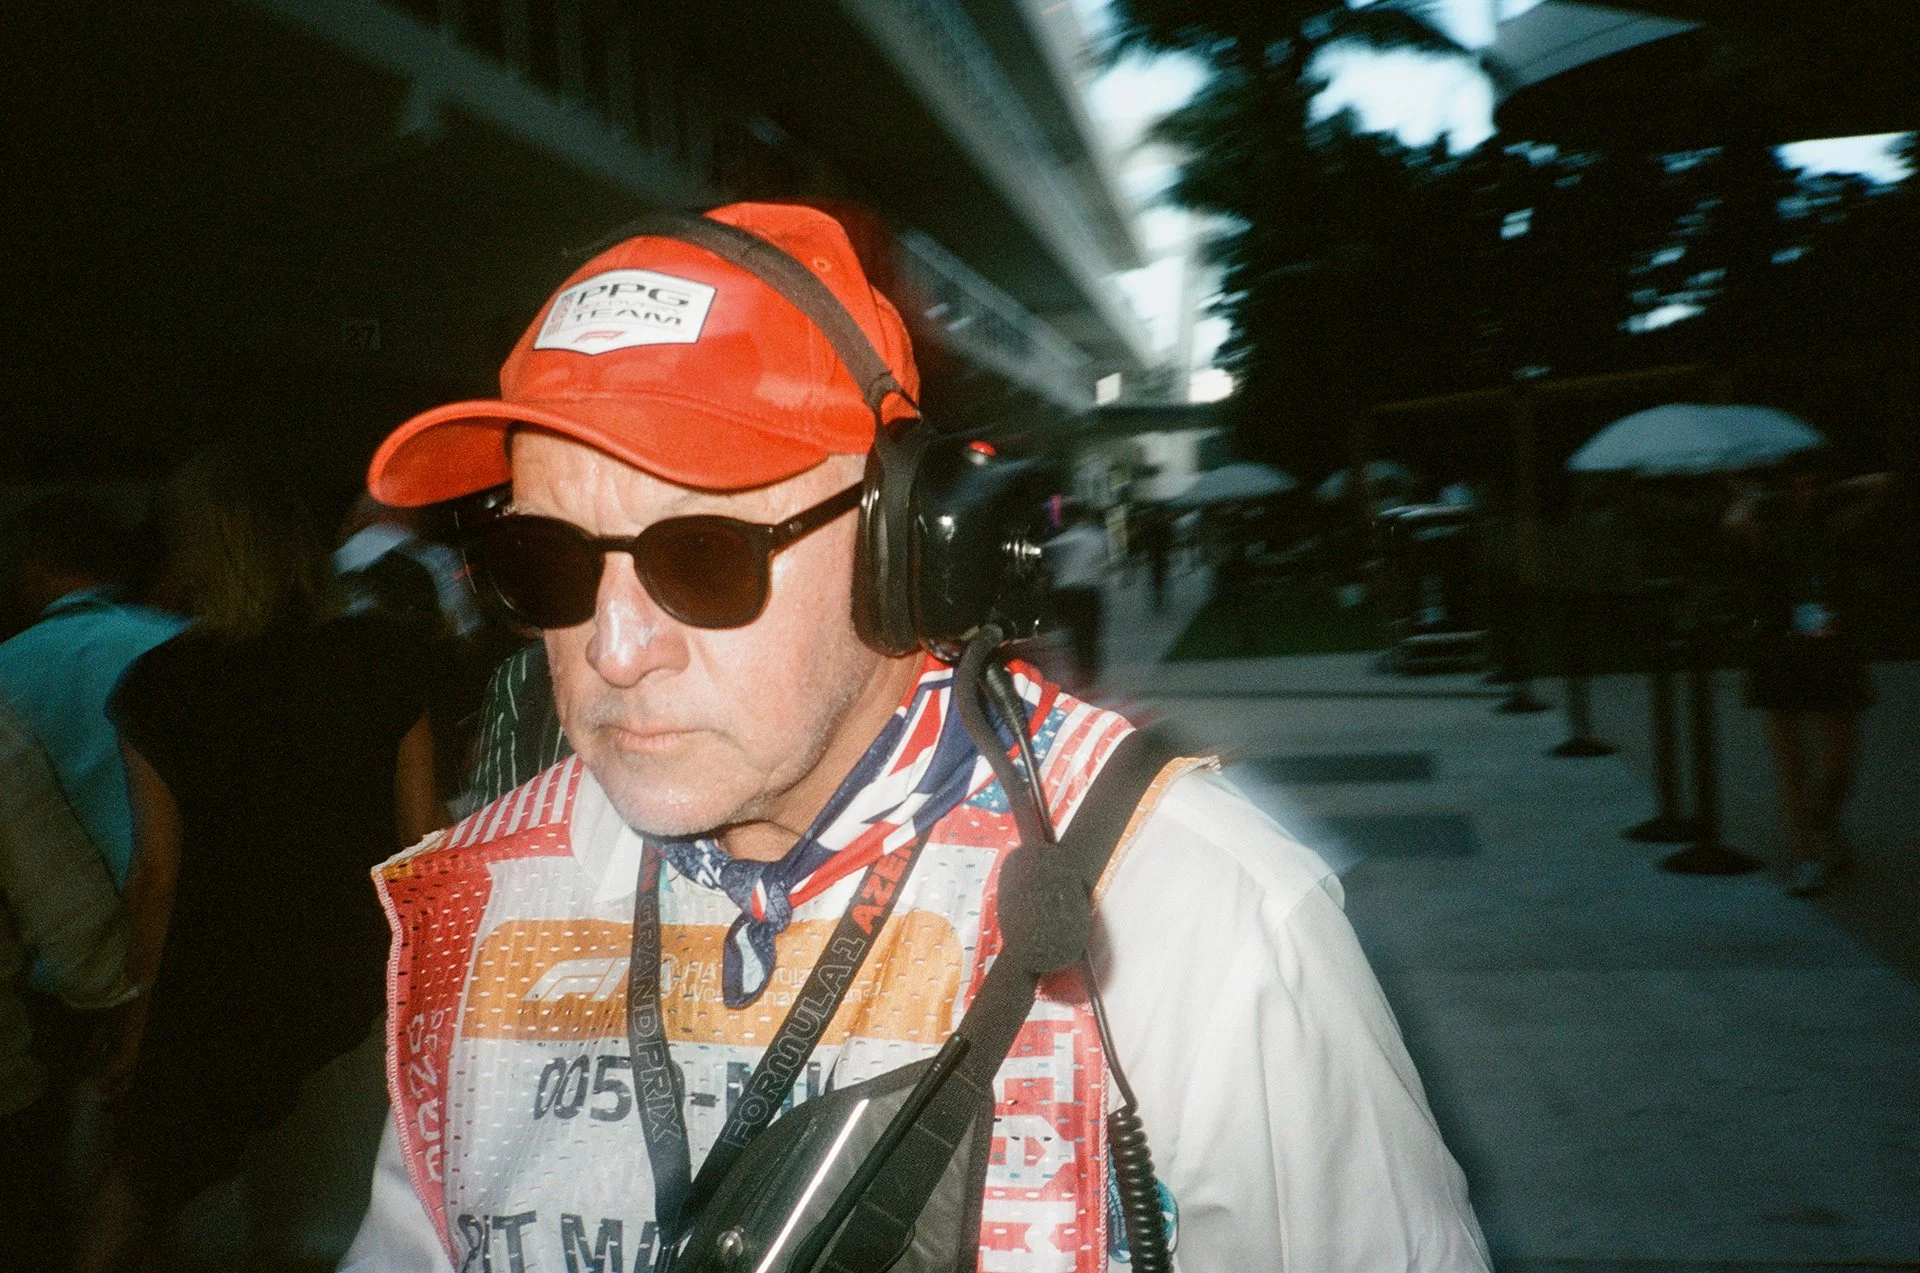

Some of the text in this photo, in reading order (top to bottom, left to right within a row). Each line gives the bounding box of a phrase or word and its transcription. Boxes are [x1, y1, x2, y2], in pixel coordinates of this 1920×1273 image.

[574, 308, 682, 325] TEAM
[577, 283, 690, 308] PPG
[722, 964, 852, 1149] FORMULA
[637, 1040, 683, 1143] PRIX
